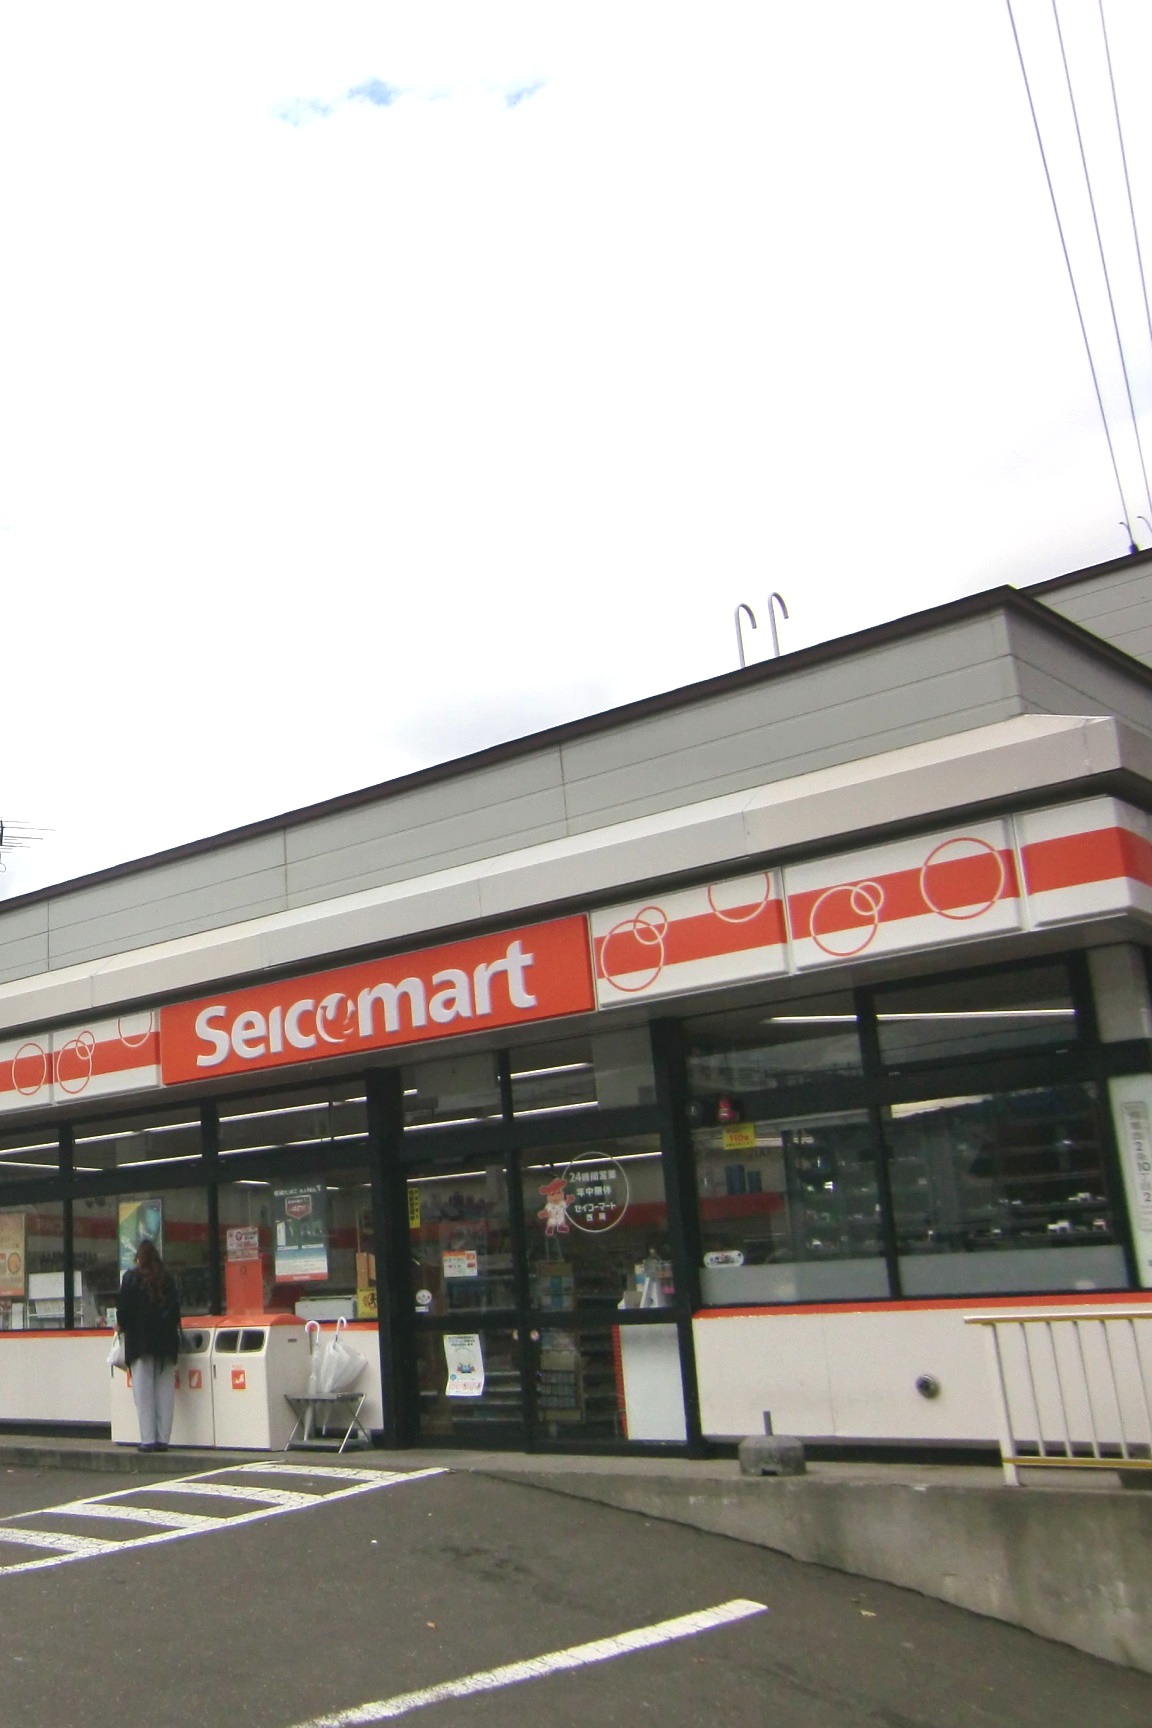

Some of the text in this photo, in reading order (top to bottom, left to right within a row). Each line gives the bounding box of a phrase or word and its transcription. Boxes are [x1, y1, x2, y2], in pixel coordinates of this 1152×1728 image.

[574, 1202, 616, 1212] セイコーマート
